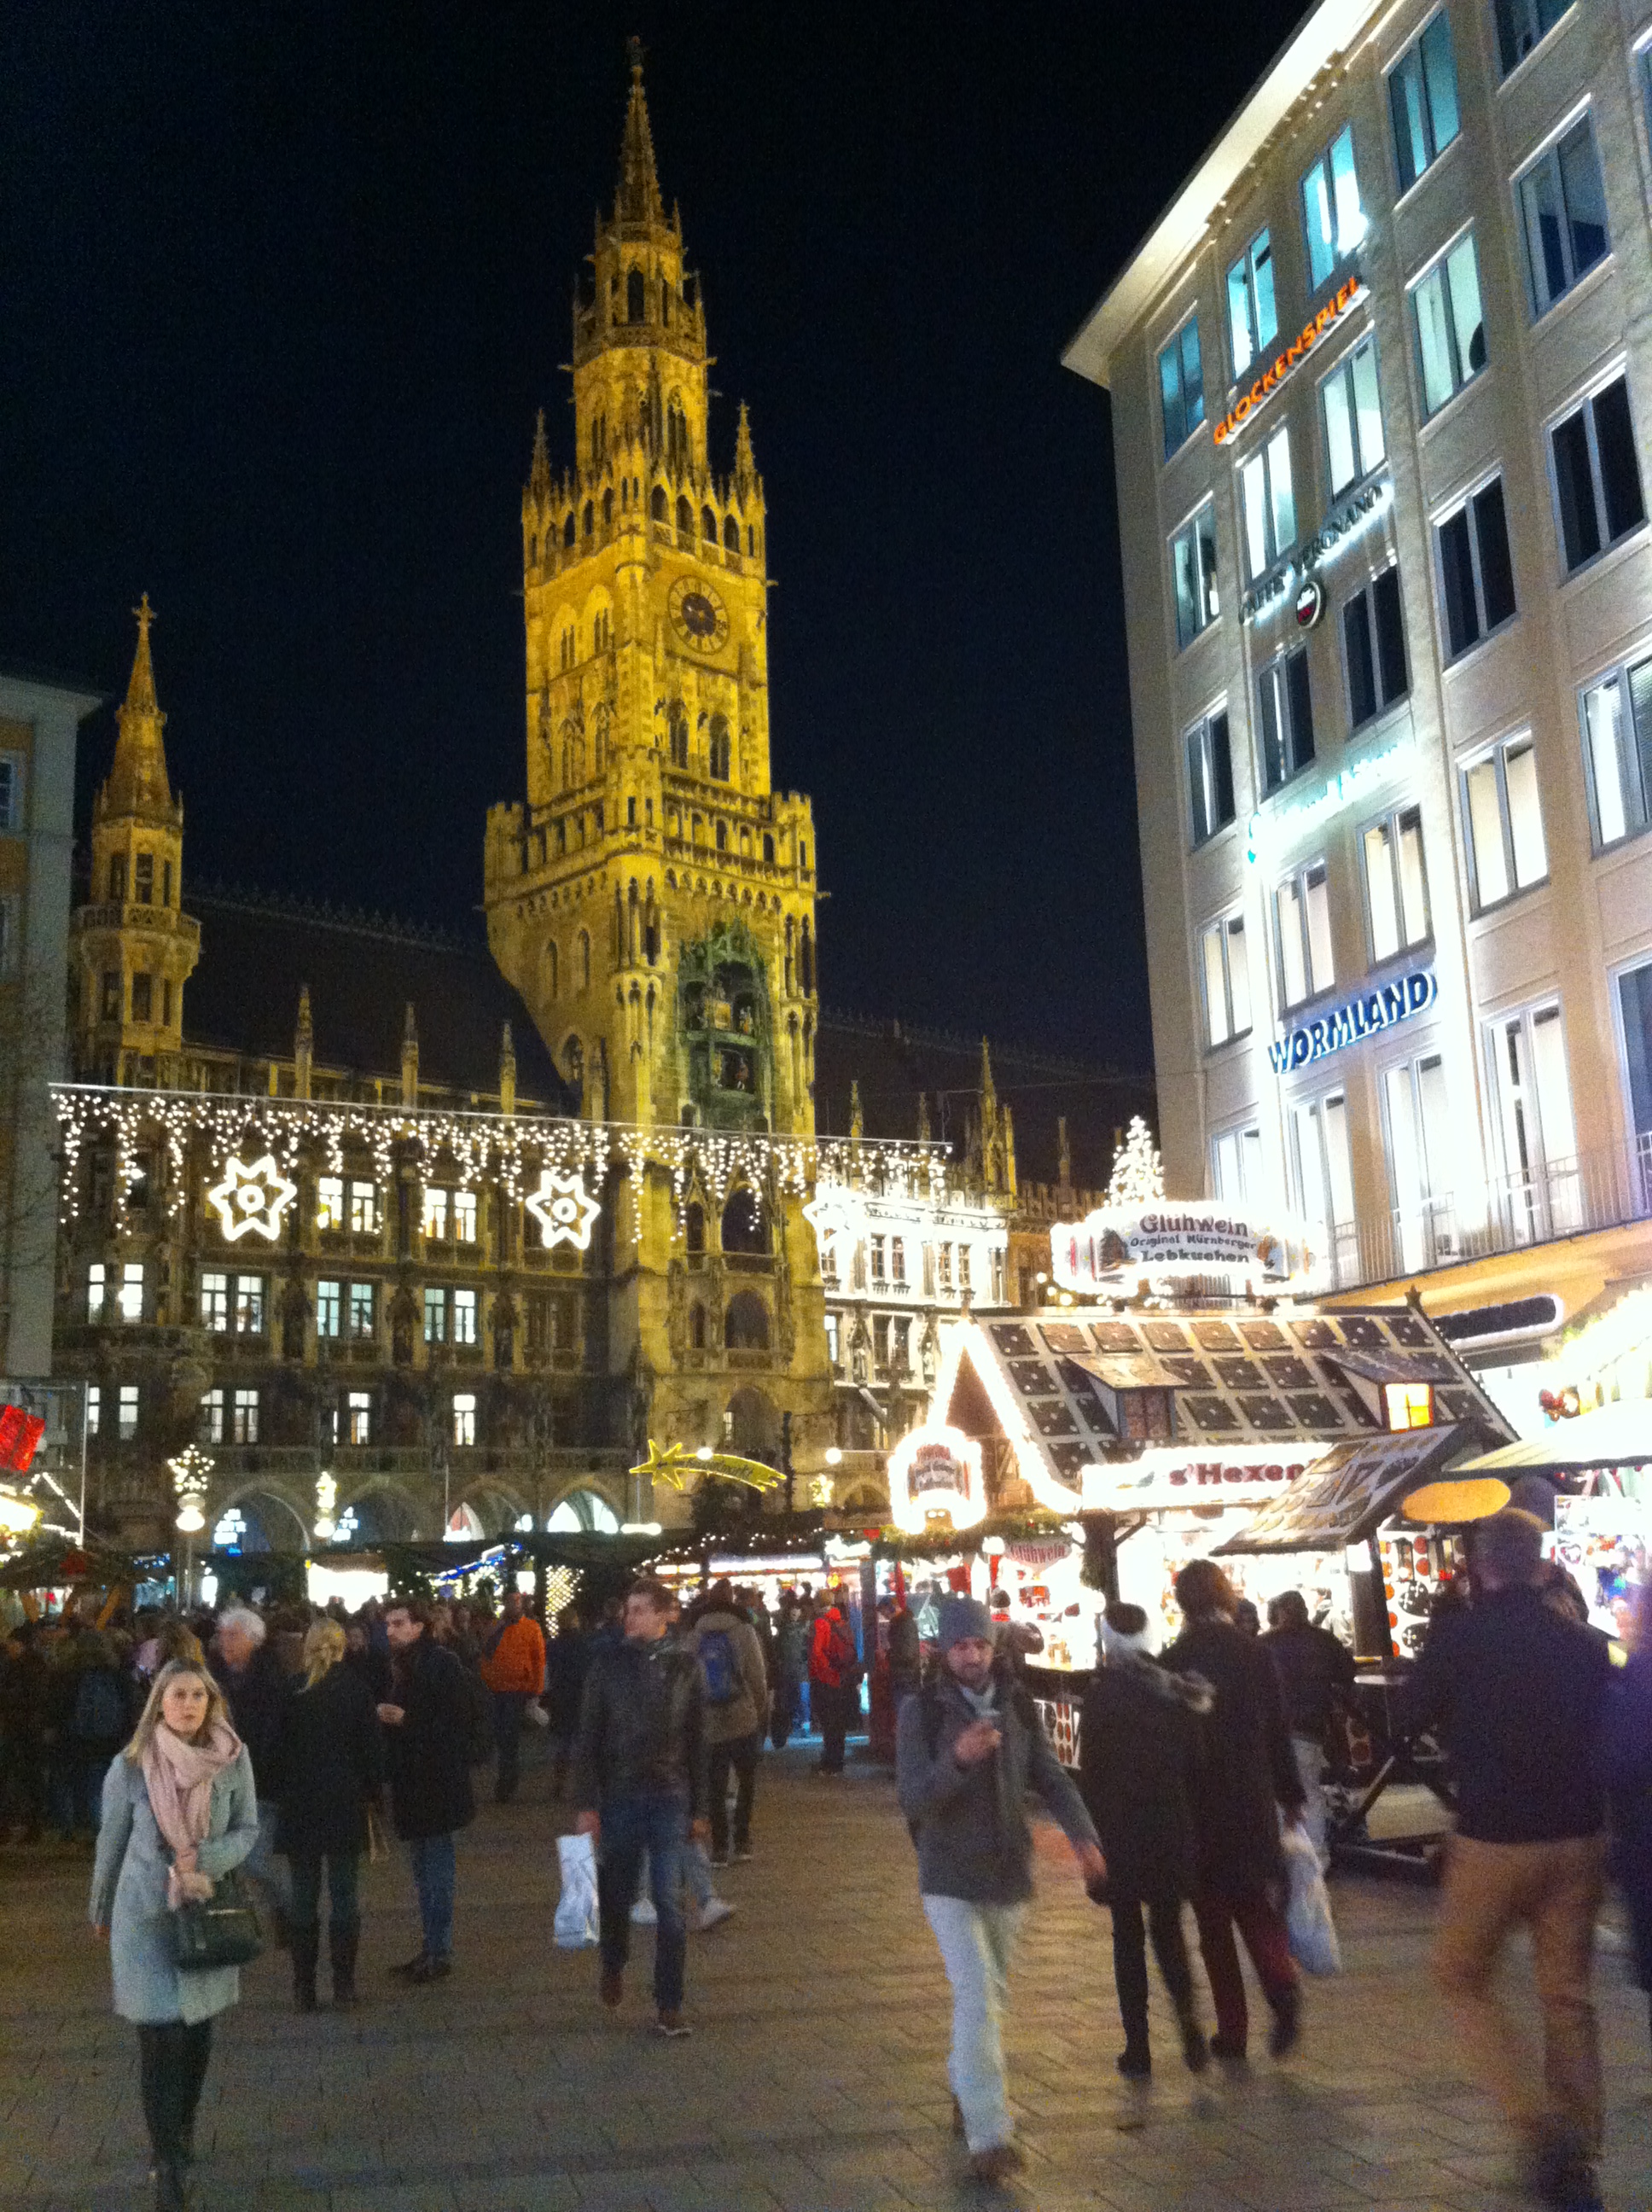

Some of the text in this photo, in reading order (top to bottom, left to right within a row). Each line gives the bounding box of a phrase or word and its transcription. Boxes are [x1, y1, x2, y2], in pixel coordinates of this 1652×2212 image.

[1213, 276, 1359, 445] GLOCKENSPIEL
[1268, 971, 1438, 1074] WORMLAND
[1139, 1213, 1248, 1237] Glühwein
[1130, 1234, 1258, 1250] Original Nürnberger
[1141, 1249, 1250, 1263] Lebkuchen
